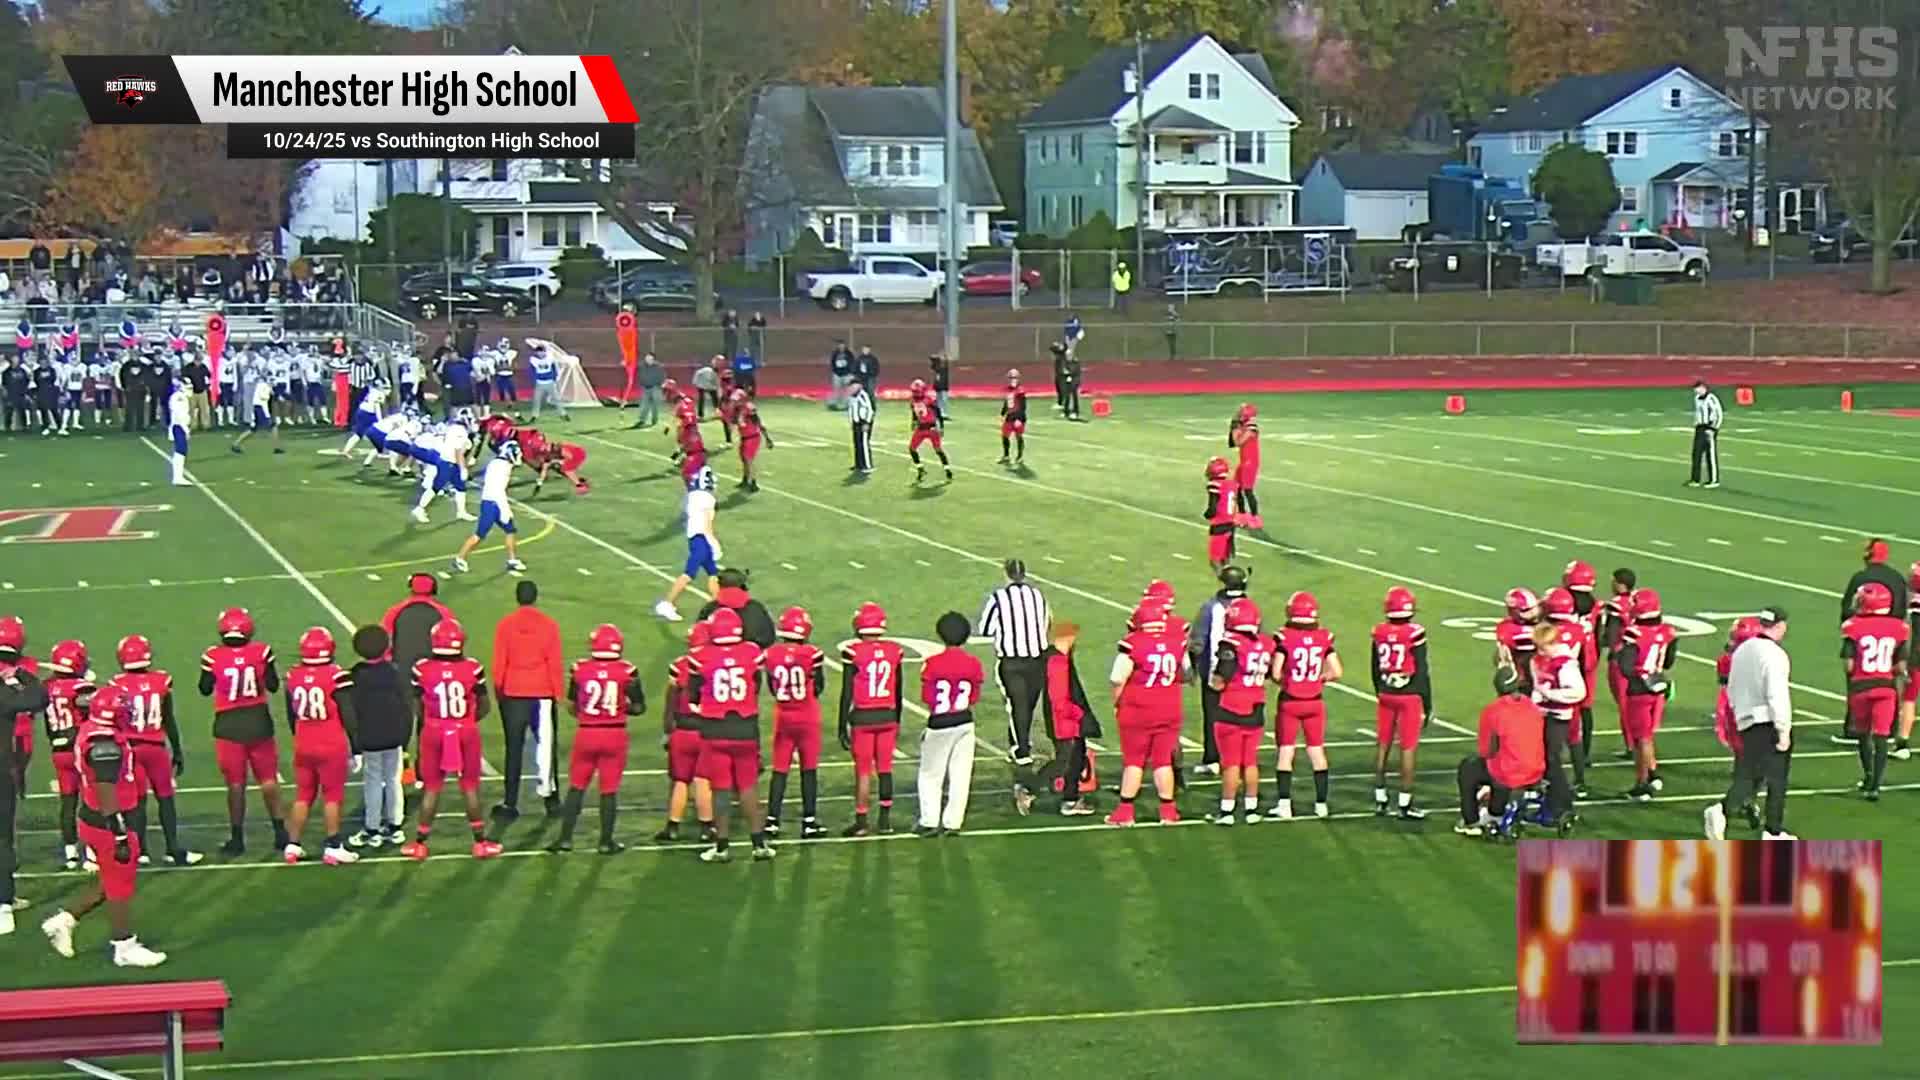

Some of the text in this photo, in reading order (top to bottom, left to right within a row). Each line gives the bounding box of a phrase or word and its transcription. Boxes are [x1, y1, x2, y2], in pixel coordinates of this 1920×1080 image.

[1146, 653, 1176, 688] 79
[1292, 647, 1323, 683] 35
[1860, 635, 1897, 673] 20
[224, 666, 259, 702] 74
[712, 667, 748, 703] 65
[774, 664, 806, 702] 20
[866, 660, 892, 698] 12
[293, 686, 327, 720] 28
[433, 680, 467, 719] 18
[584, 680, 619, 717] 24
